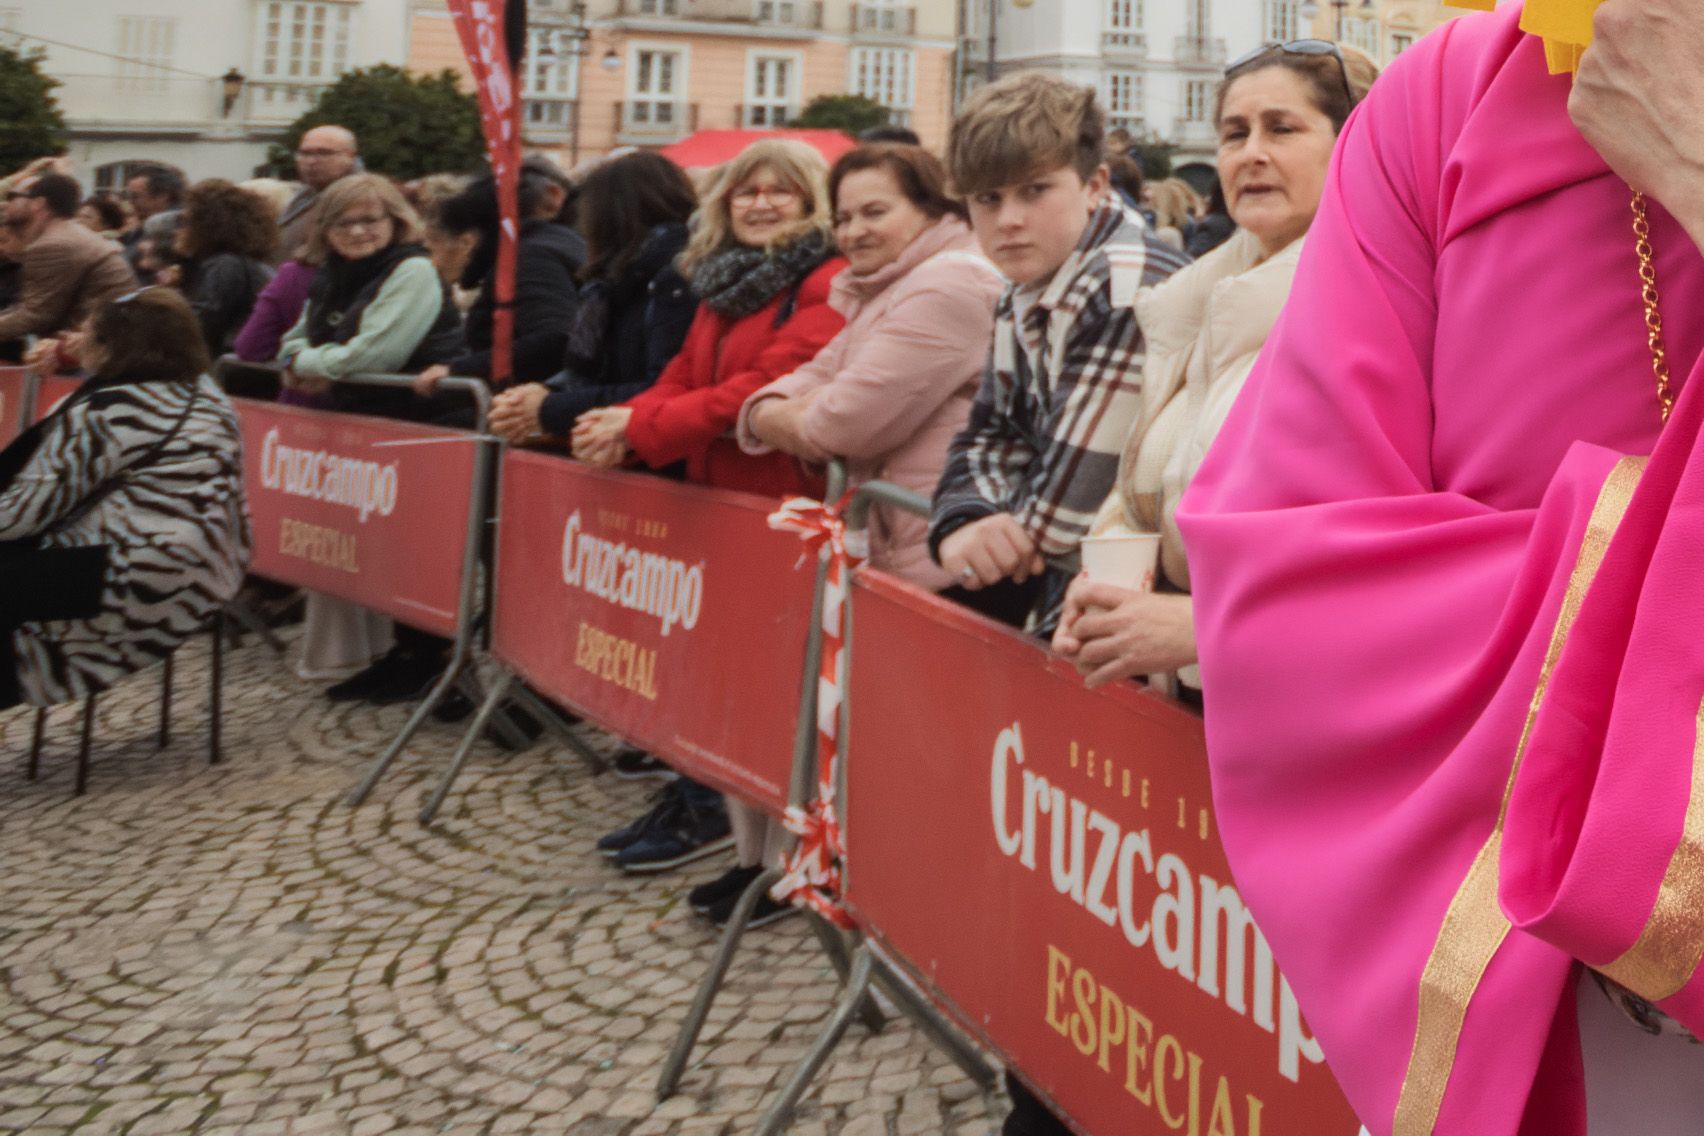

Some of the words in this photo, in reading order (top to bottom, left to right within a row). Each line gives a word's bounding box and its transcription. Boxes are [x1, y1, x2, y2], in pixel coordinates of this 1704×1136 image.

[261, 426, 398, 523] Cruzcampo
[563, 508, 703, 637] Cruzcampo
[575, 621, 657, 700] ESPECIAL
[1070, 740, 1149, 809] DESDE
[991, 720, 1326, 1084] Cruzcamp
